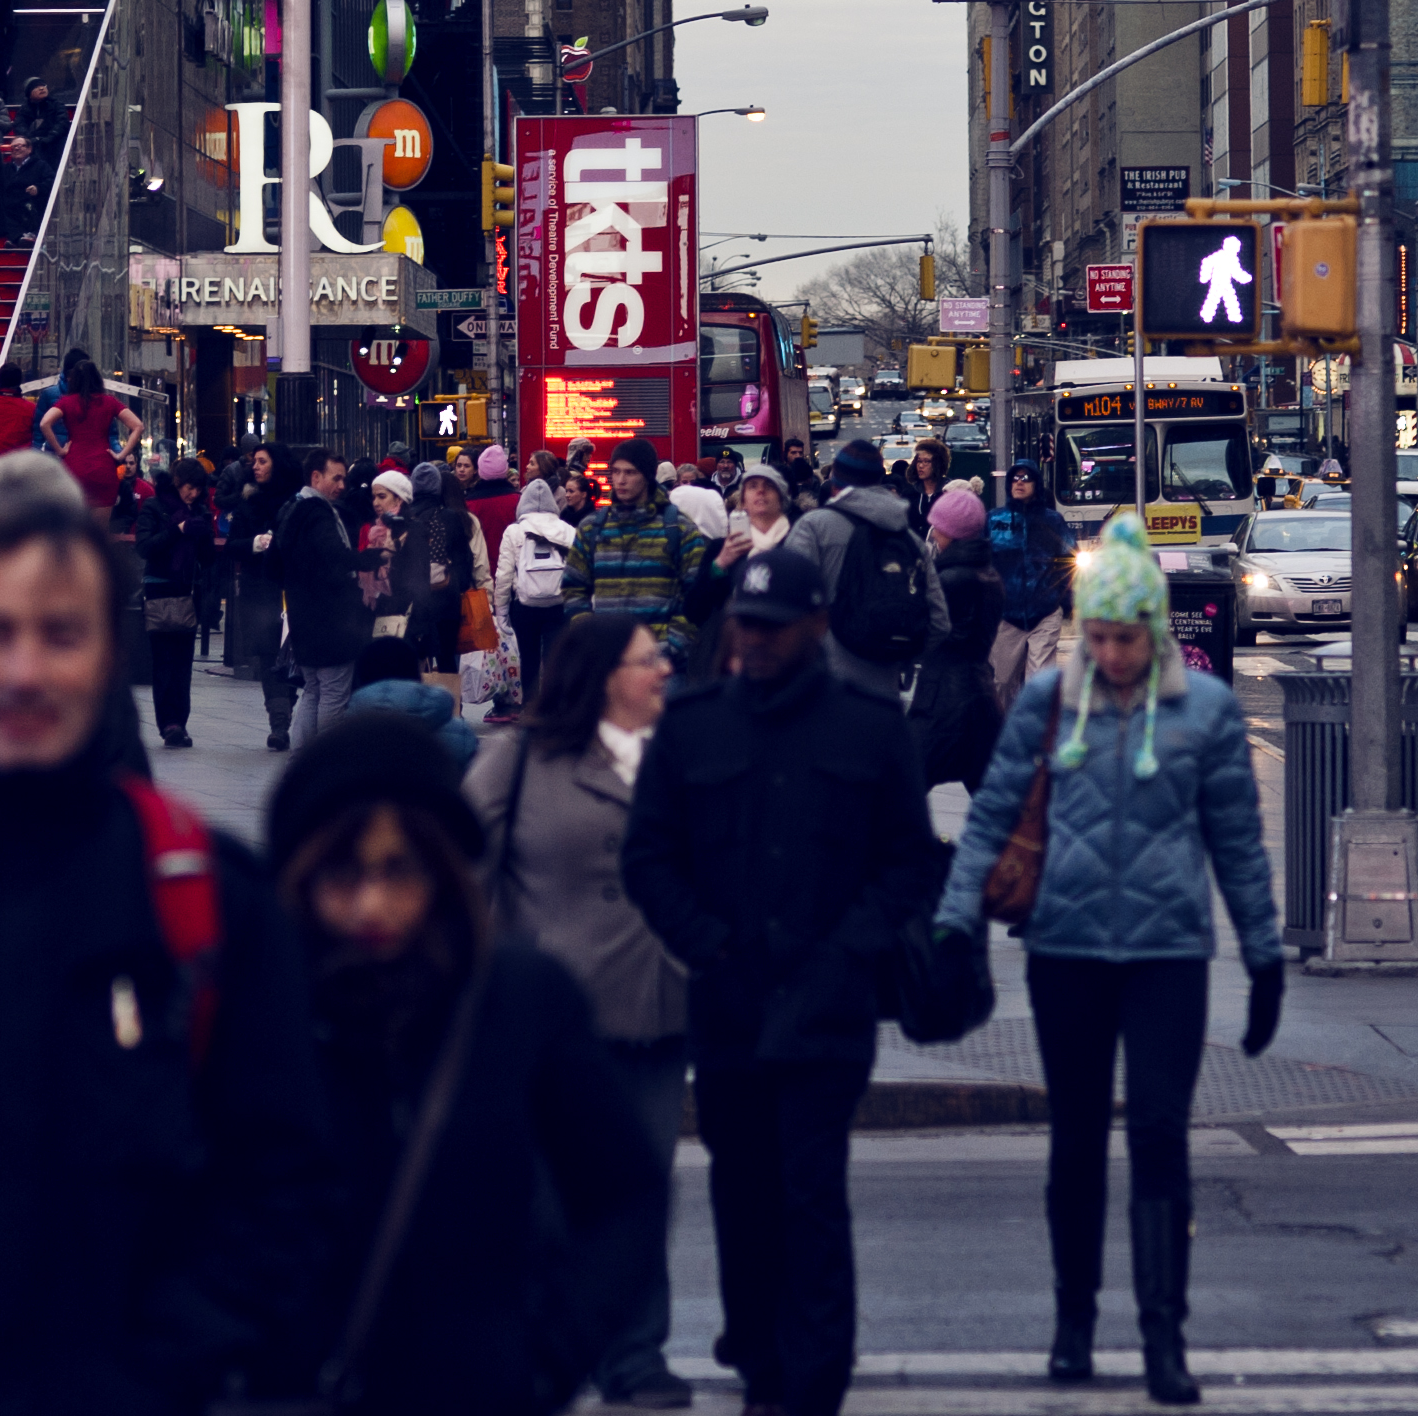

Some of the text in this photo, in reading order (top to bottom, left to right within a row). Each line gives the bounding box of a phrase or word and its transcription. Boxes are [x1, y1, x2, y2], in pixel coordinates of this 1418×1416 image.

[548, 160, 556, 197] service
[1124, 170, 1187, 181] THE IRISH PUB
[1135, 181, 1183, 189] Restaurant
[548, 198, 559, 209] of
[548, 211, 559, 251] Theatre
[563, 138, 668, 352] tkts
[1090, 269, 1131, 279] NO STANDING
[182, 275, 398, 303] RENAIANCE
[547, 254, 559, 322] Development
[1095, 282, 1126, 292] ANYTIME
[417, 291, 481, 304] FATHER DUFFY
[955, 301, 987, 309] STANDING
[948, 310, 981, 319] ANYTIME
[467, 322, 488, 333] ON
[548, 324, 559, 350] Fund
[1084, 395, 1122, 416] M104
[1190, 397, 1204, 408] AV
[1145, 515, 1198, 530] LEEPYS
